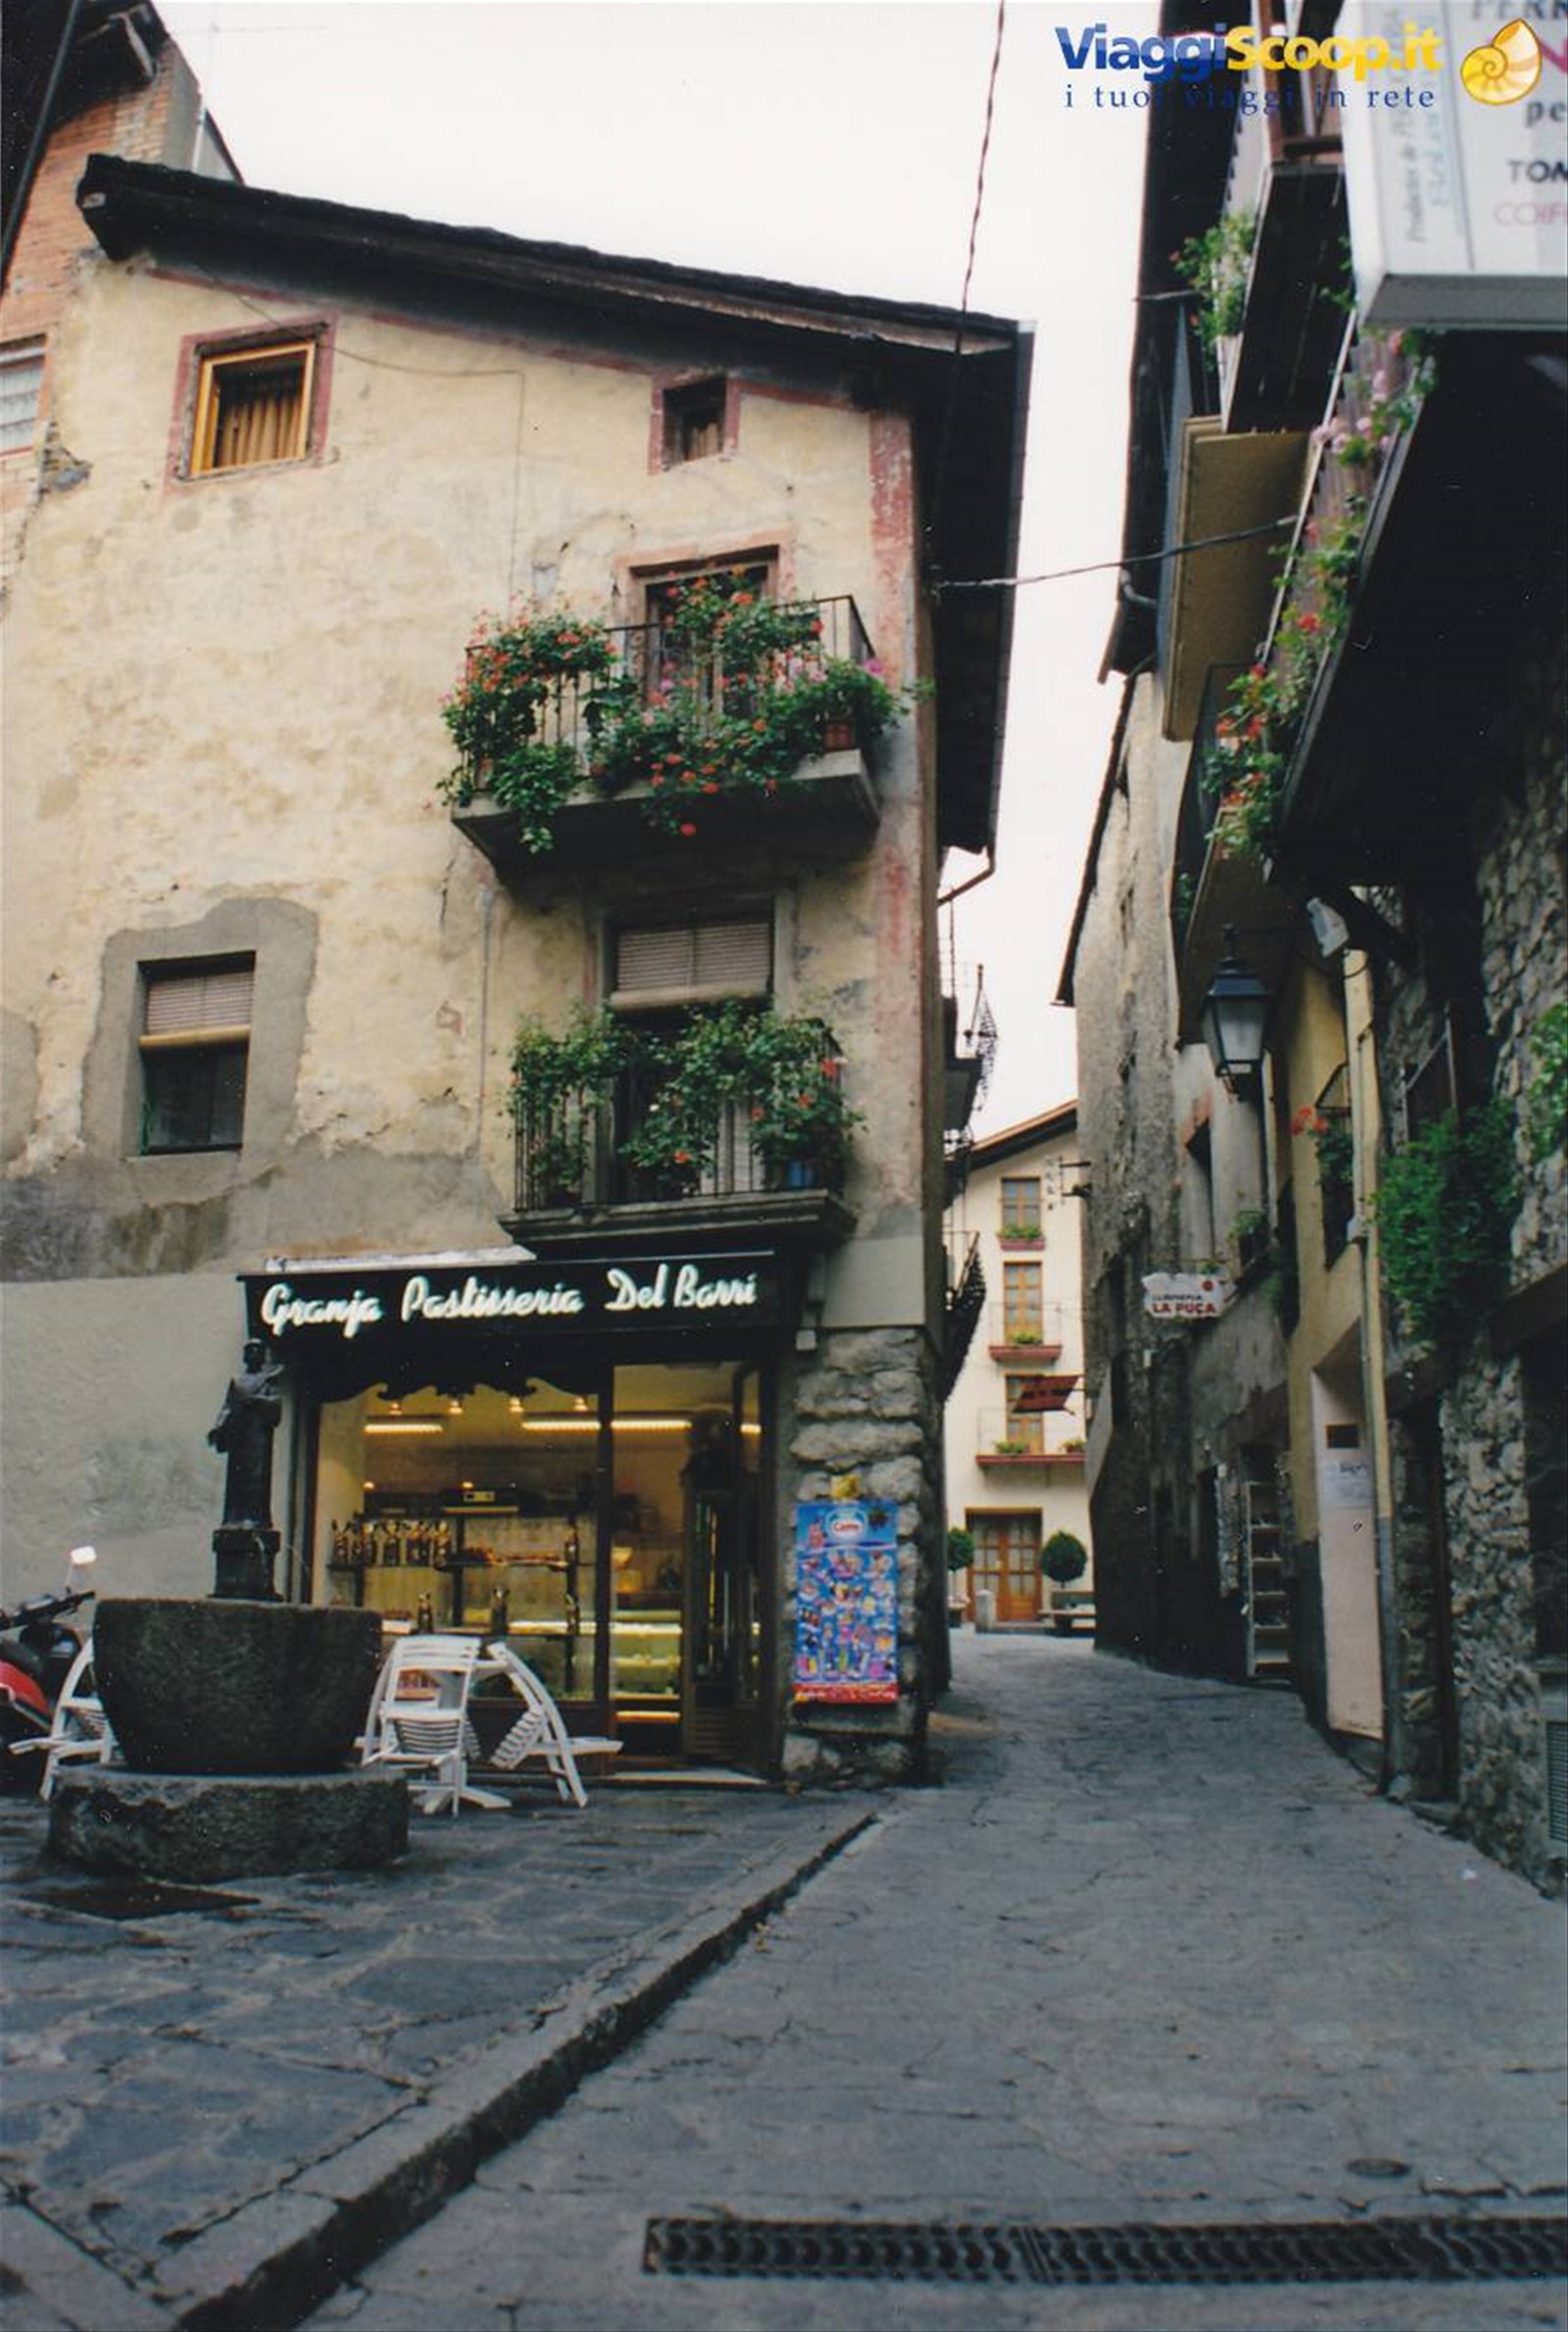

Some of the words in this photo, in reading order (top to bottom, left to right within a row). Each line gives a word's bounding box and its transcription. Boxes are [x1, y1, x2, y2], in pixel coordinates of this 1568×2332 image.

[261, 1282, 383, 1338] Granja
[401, 1274, 585, 1321] Pastisseria
[605, 1264, 666, 1312] Del
[672, 1264, 759, 1310] Barri
[1152, 1303, 1171, 1314] LA
